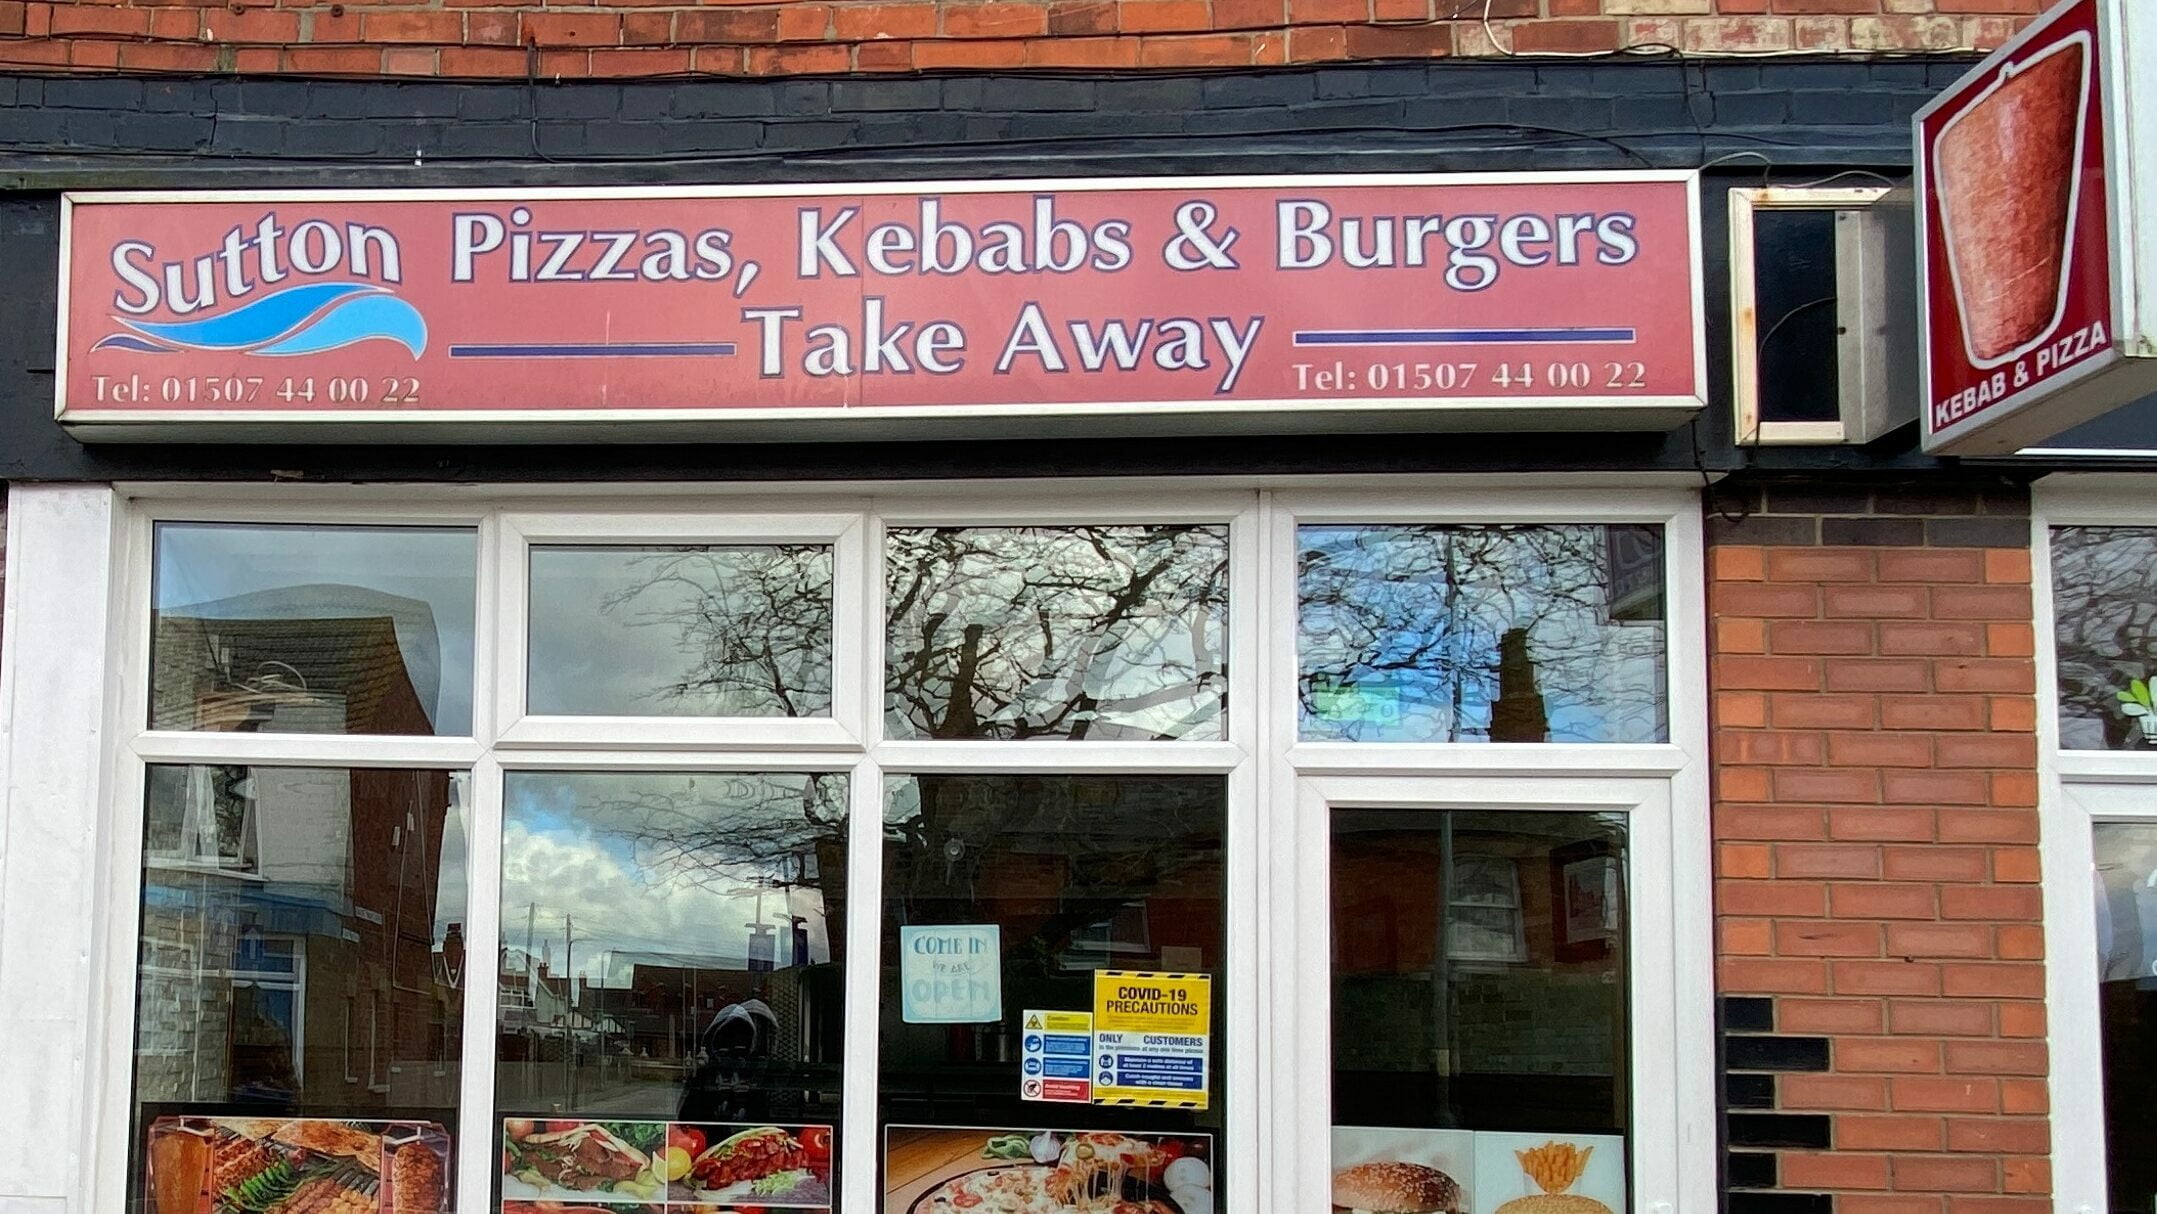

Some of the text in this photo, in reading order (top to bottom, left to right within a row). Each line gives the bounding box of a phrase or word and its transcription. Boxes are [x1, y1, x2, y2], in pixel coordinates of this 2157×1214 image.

[451, 195, 1638, 298] Pizzas, Kebabs & Burgers
[110, 211, 402, 315] Sutton
[741, 297, 1265, 394] Take Away
[1292, 361, 1647, 392] Tel: 01507 44 00 22
[1935, 320, 2107, 428] KEBAB & PIZZA
[92, 375, 421, 404] Tel: 01507 44 00 22
[914, 936, 963, 955] COME
[911, 979, 991, 1004] OPEN
[1118, 986, 1187, 1002] COVID-19
[1106, 1000, 1198, 1016] PRECAUTIONS
[1099, 1033, 1203, 1047] ONLY CUSTOMERS
